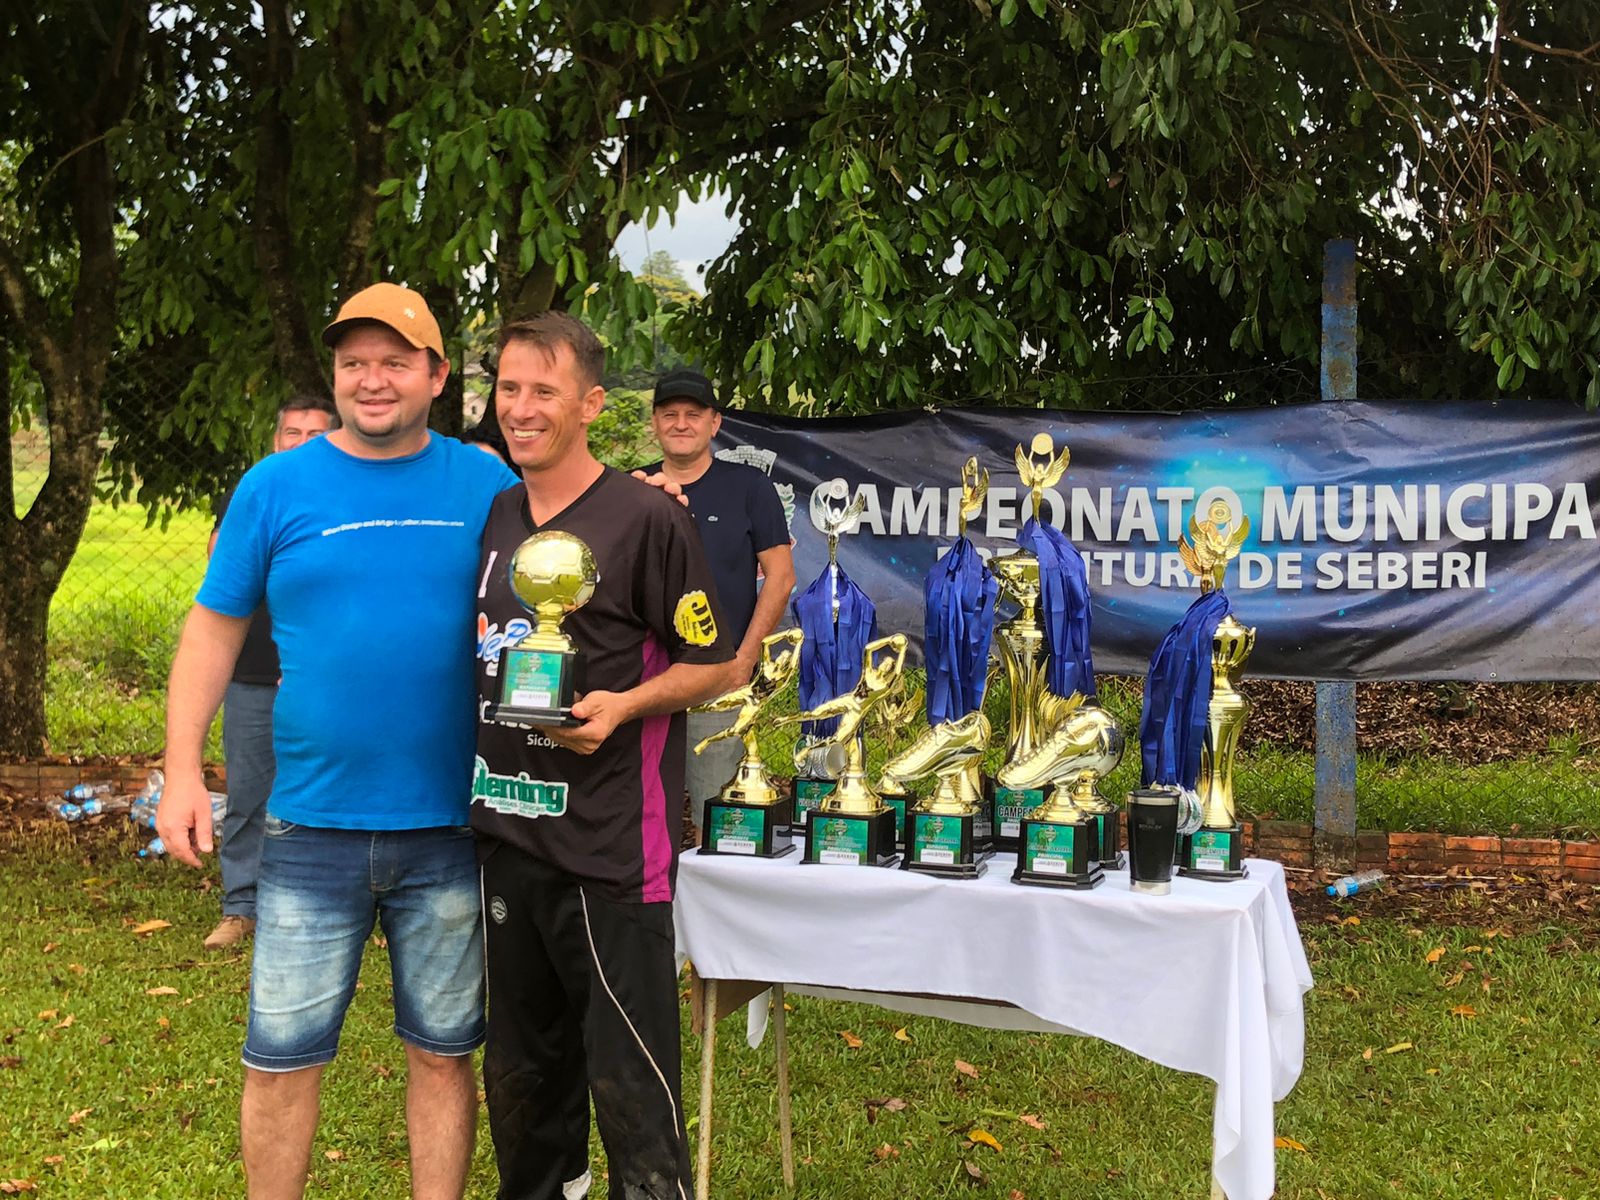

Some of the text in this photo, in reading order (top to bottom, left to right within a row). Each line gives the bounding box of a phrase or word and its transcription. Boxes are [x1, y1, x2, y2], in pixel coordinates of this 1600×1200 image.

[1261, 483, 1597, 542] MUNICIPA
[1240, 552, 1302, 589] DE
[1316, 552, 1487, 589] SEBERI
[473, 768, 565, 813] leming
